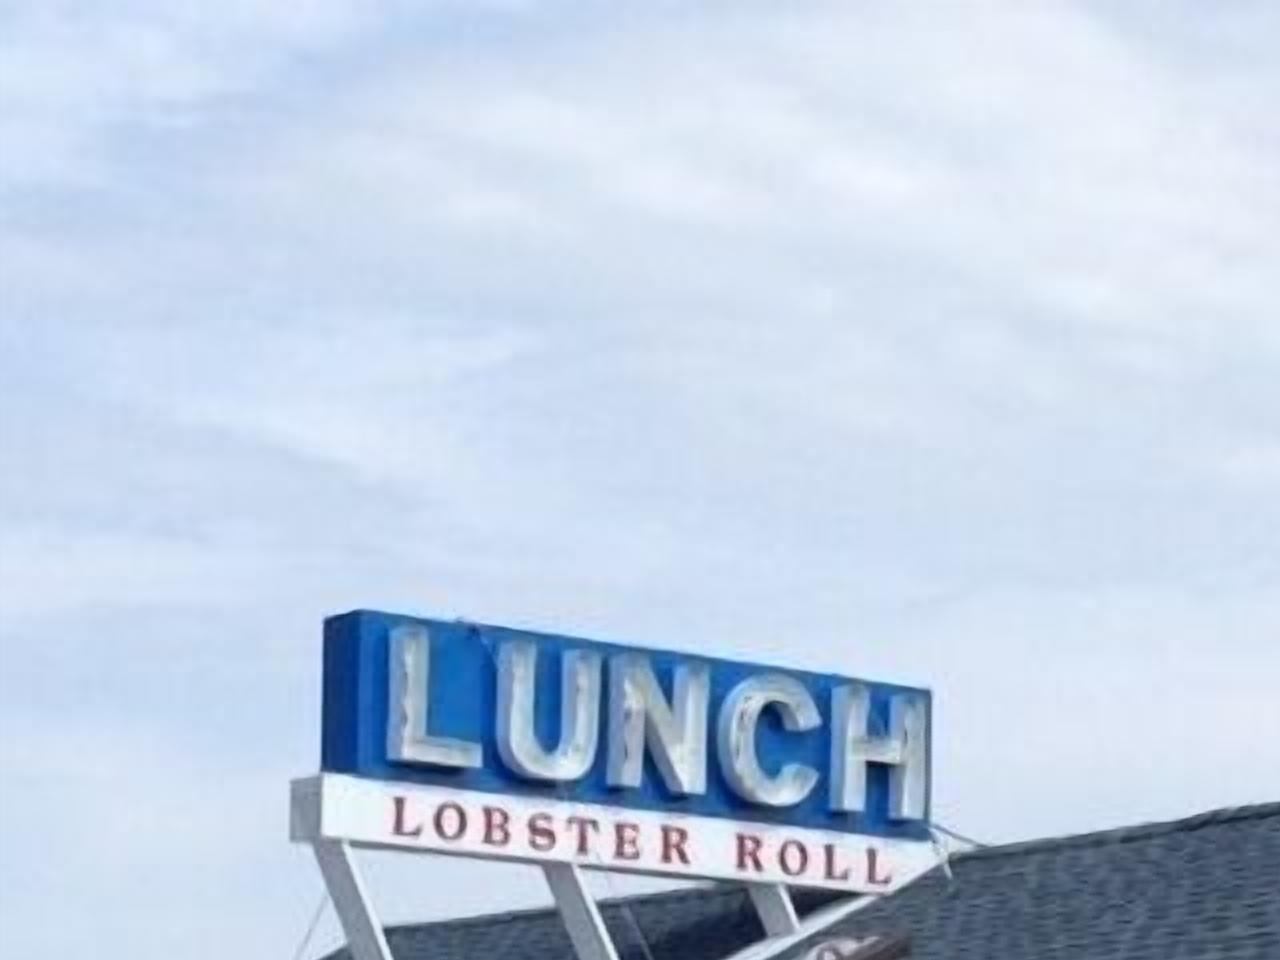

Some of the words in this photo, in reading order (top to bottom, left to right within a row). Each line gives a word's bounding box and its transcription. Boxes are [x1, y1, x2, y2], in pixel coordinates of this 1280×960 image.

[386, 624, 929, 821] LUNCH
[391, 796, 690, 865] LOBSTER
[735, 833, 892, 886] ROLL
